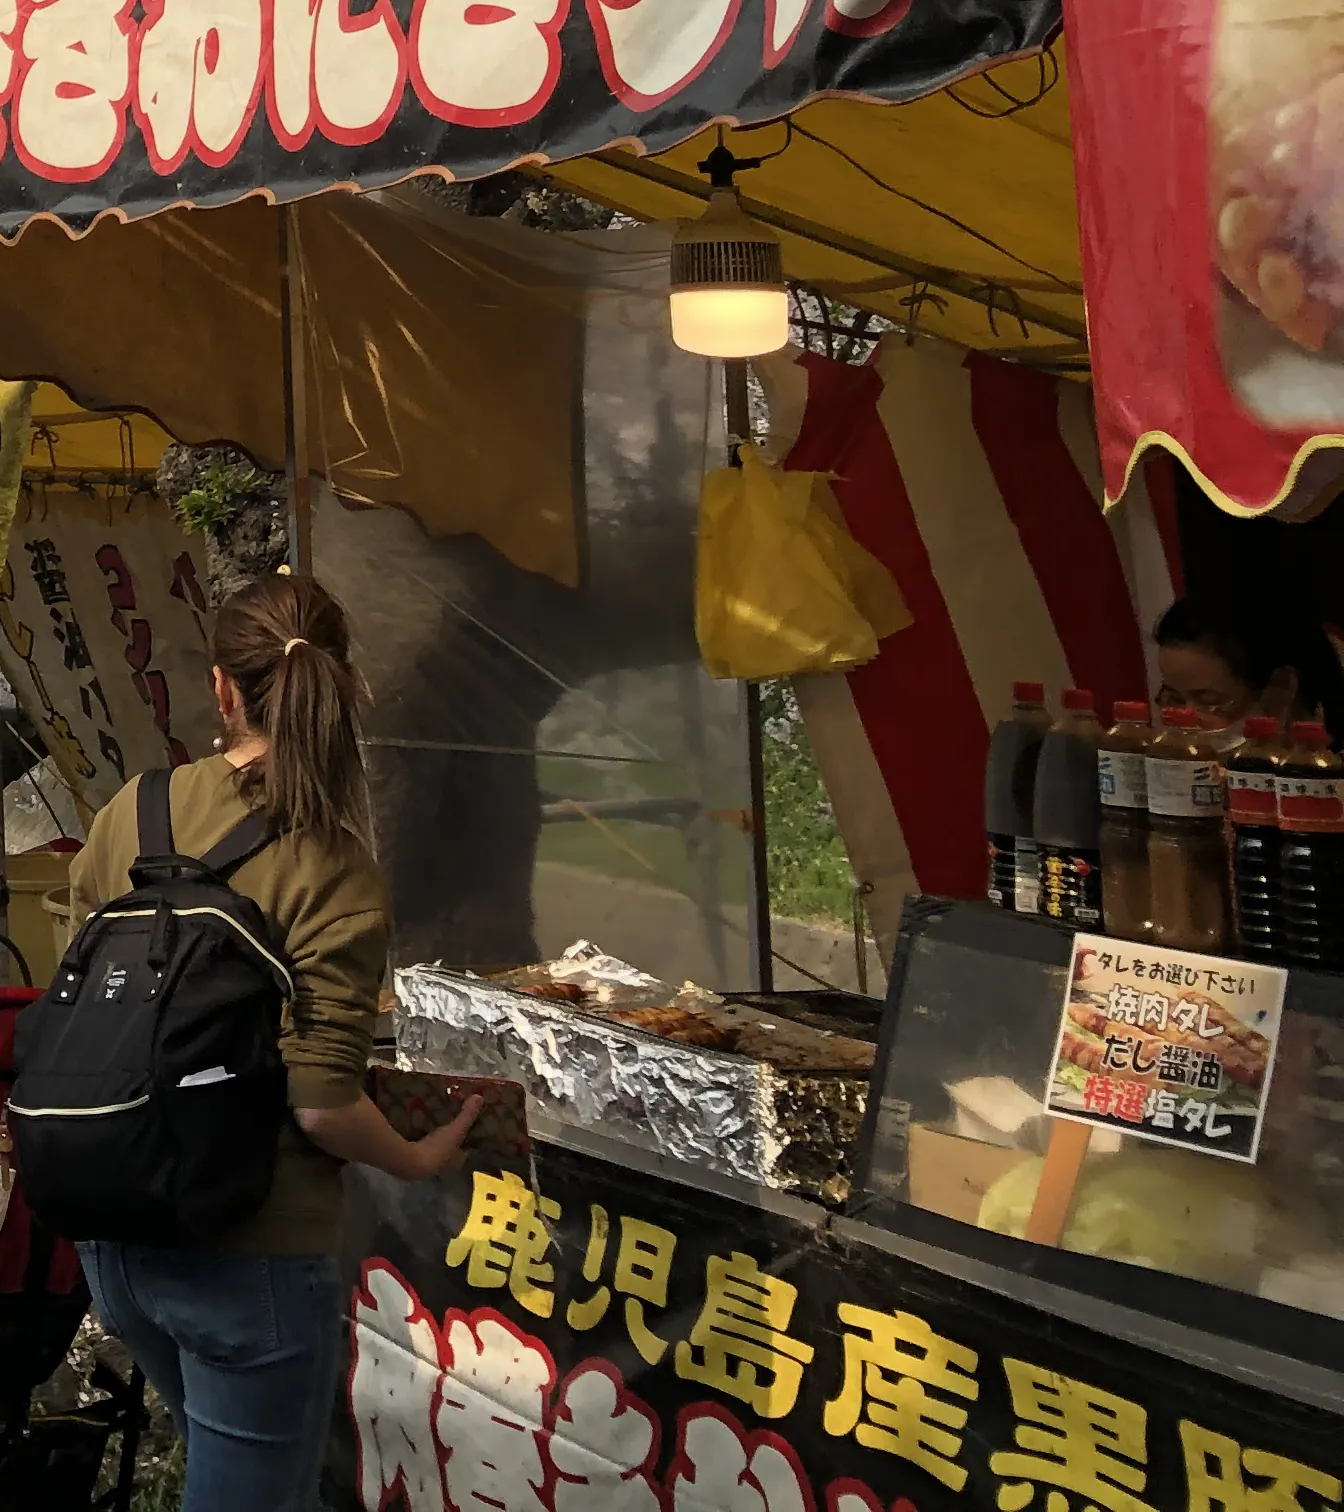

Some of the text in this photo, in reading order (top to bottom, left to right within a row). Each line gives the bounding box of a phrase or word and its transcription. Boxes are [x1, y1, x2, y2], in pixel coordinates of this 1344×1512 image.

[1098, 952, 1255, 995] タレをお選び下さい
[1105, 982, 1225, 1038] 焼肉タレ
[1102, 1034, 1222, 1091] だし醤油
[1083, 1075, 1232, 1138] 特選塩タレ
